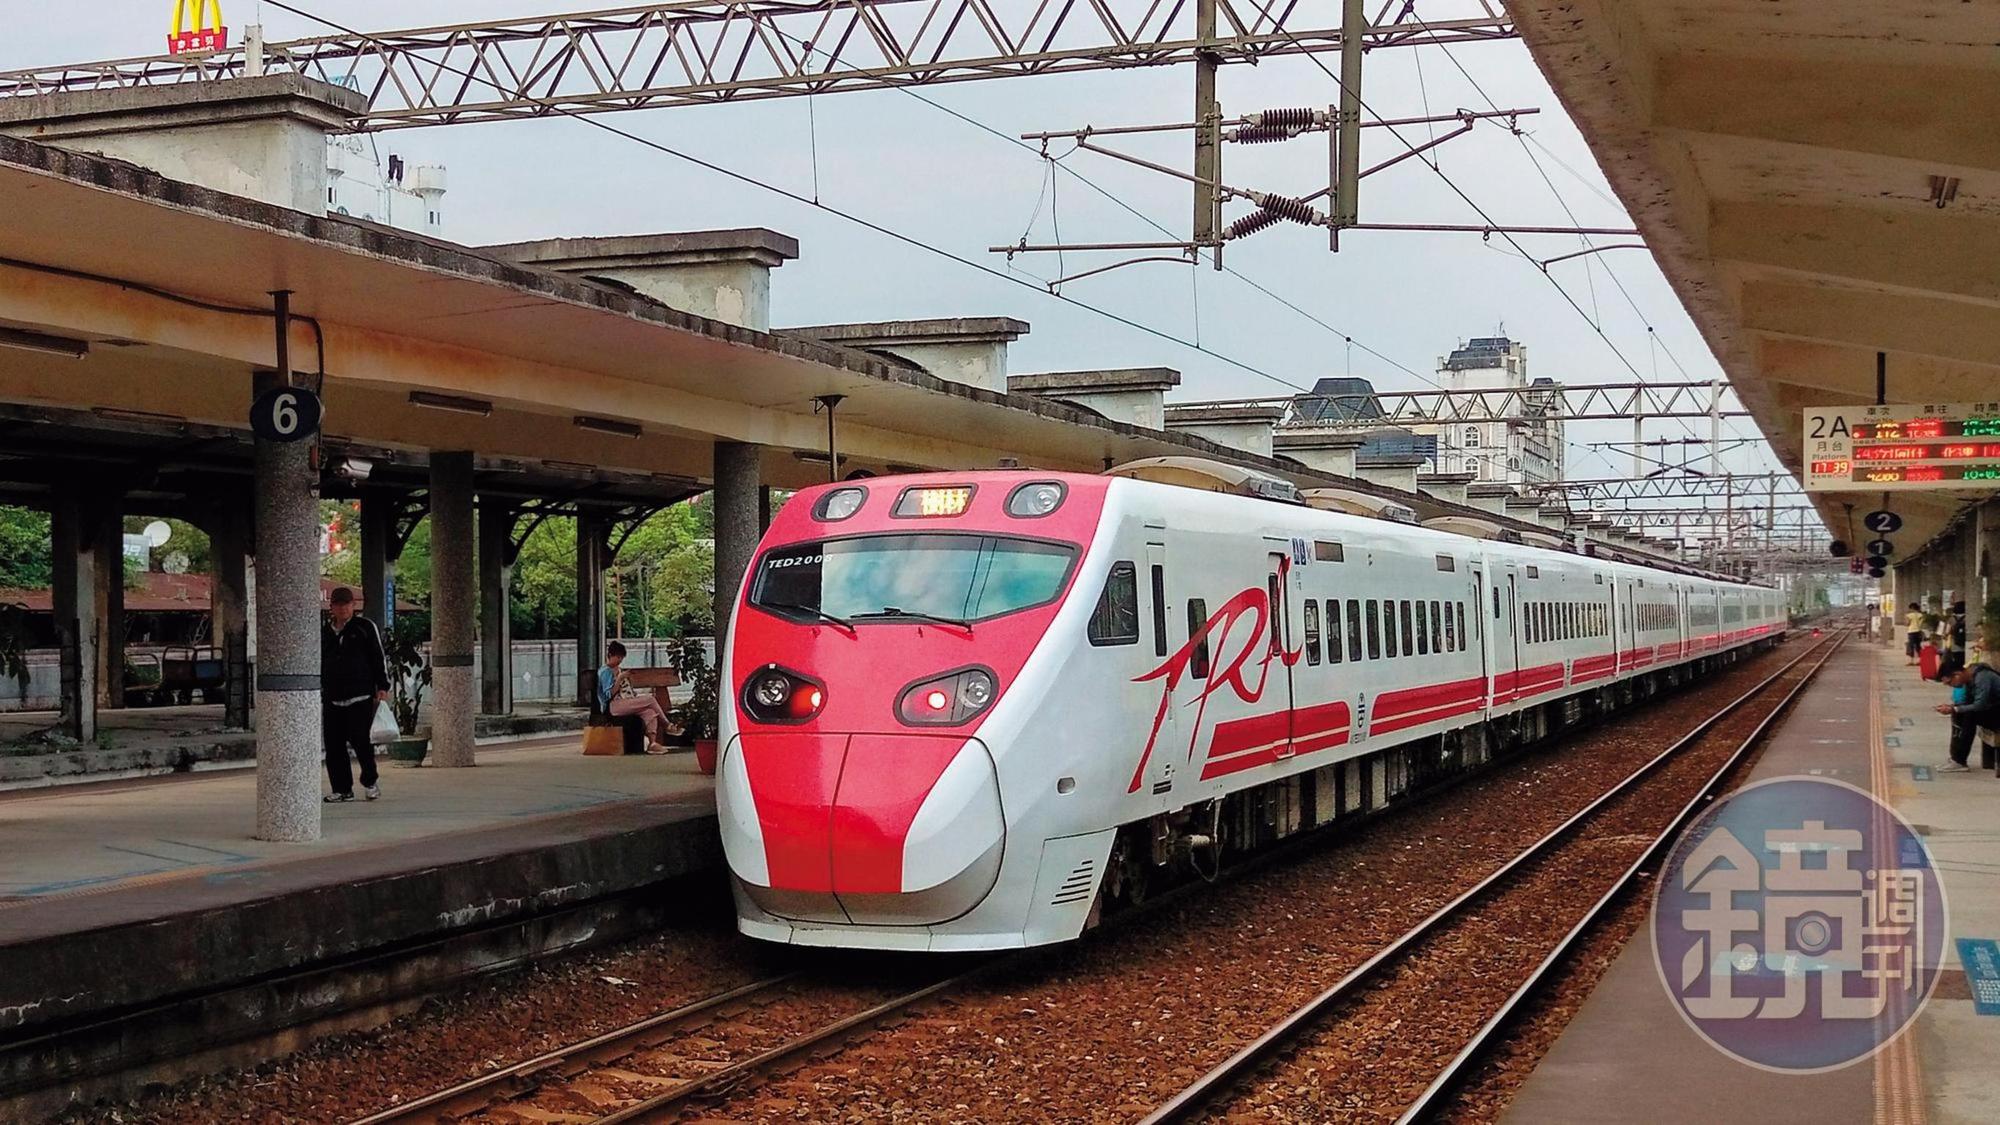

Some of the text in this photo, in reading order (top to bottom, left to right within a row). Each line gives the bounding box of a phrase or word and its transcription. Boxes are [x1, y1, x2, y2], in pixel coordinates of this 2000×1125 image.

[273, 393, 298, 434] 6
[1810, 415, 1850, 439] 2A
[1817, 441, 1842, 452] 月台
[1876, 513, 1891, 531] 2
